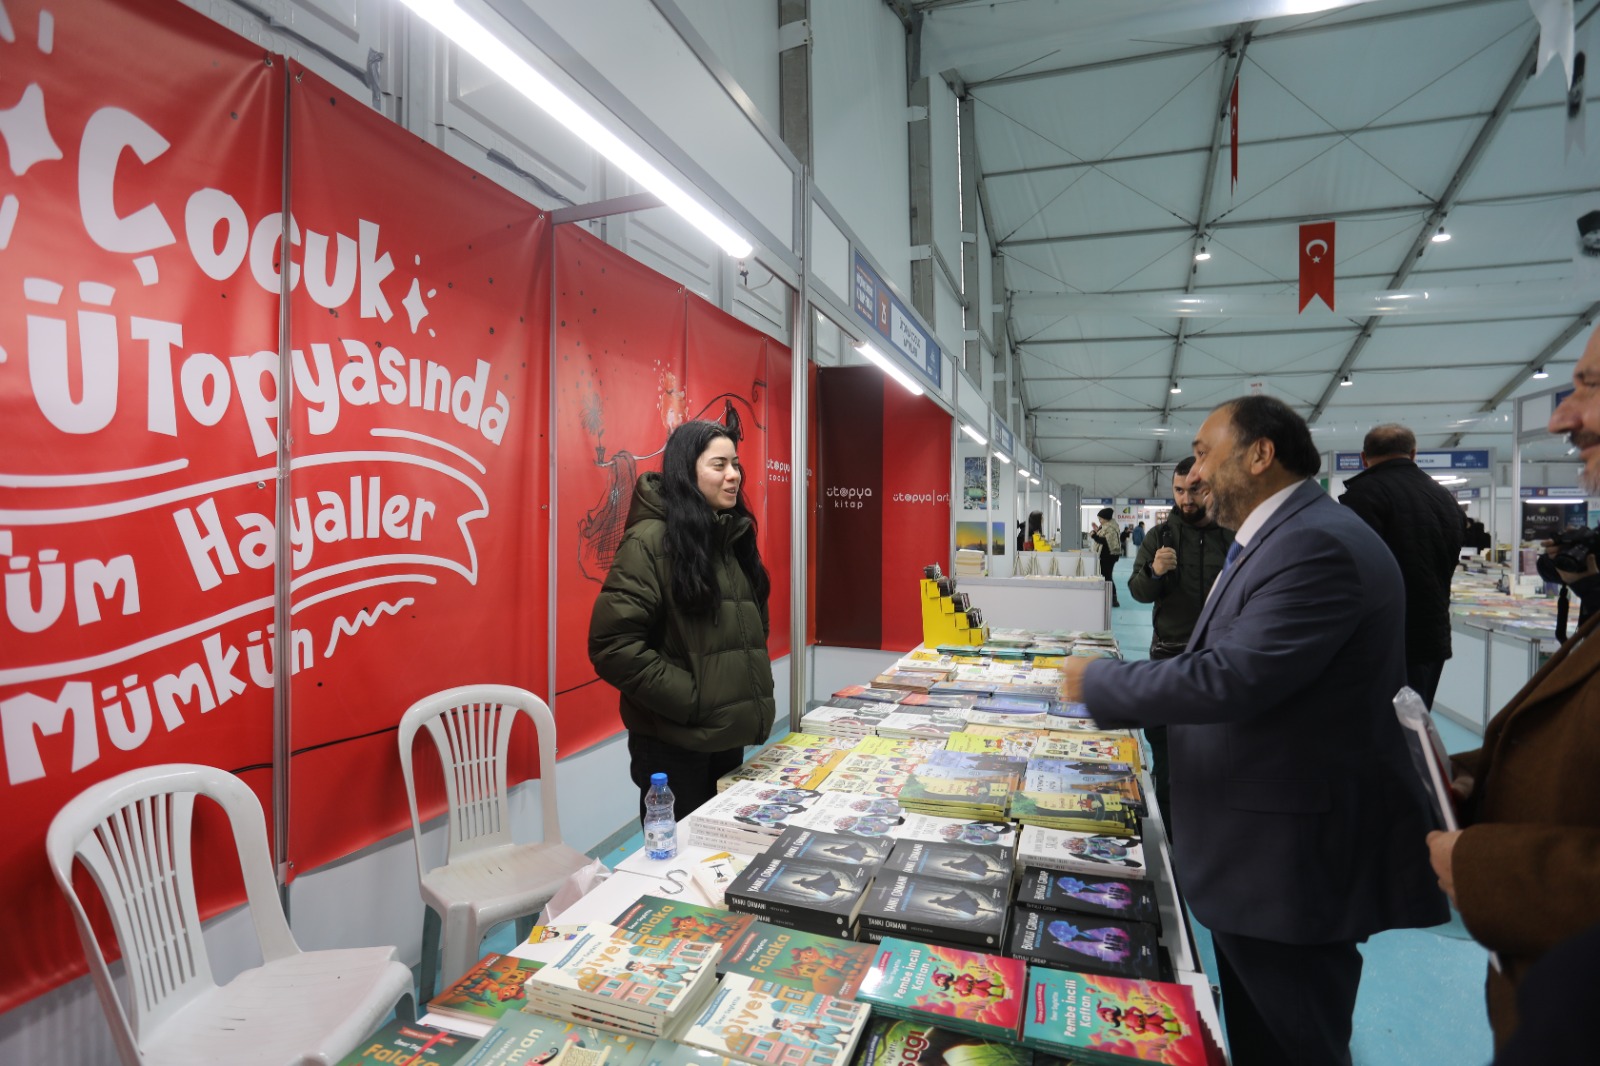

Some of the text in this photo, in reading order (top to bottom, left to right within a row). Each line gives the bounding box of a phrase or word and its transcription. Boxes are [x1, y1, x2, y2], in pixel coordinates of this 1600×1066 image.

[79, 106, 395, 323] Çocuk
[826, 486, 872, 499] ütopya
[834, 500, 863, 509] kitap
[0, 476, 436, 633] üm Hayaller
[1, 623, 313, 785] Mümkün
[639, 905, 675, 934] alaka
[750, 934, 791, 973] Falaka
[893, 971, 913, 998] Pembe
[912, 963, 930, 991] Kaftan
[1063, 1005, 1076, 1037] Pembe
[1079, 995, 1091, 1028] Kaftan
